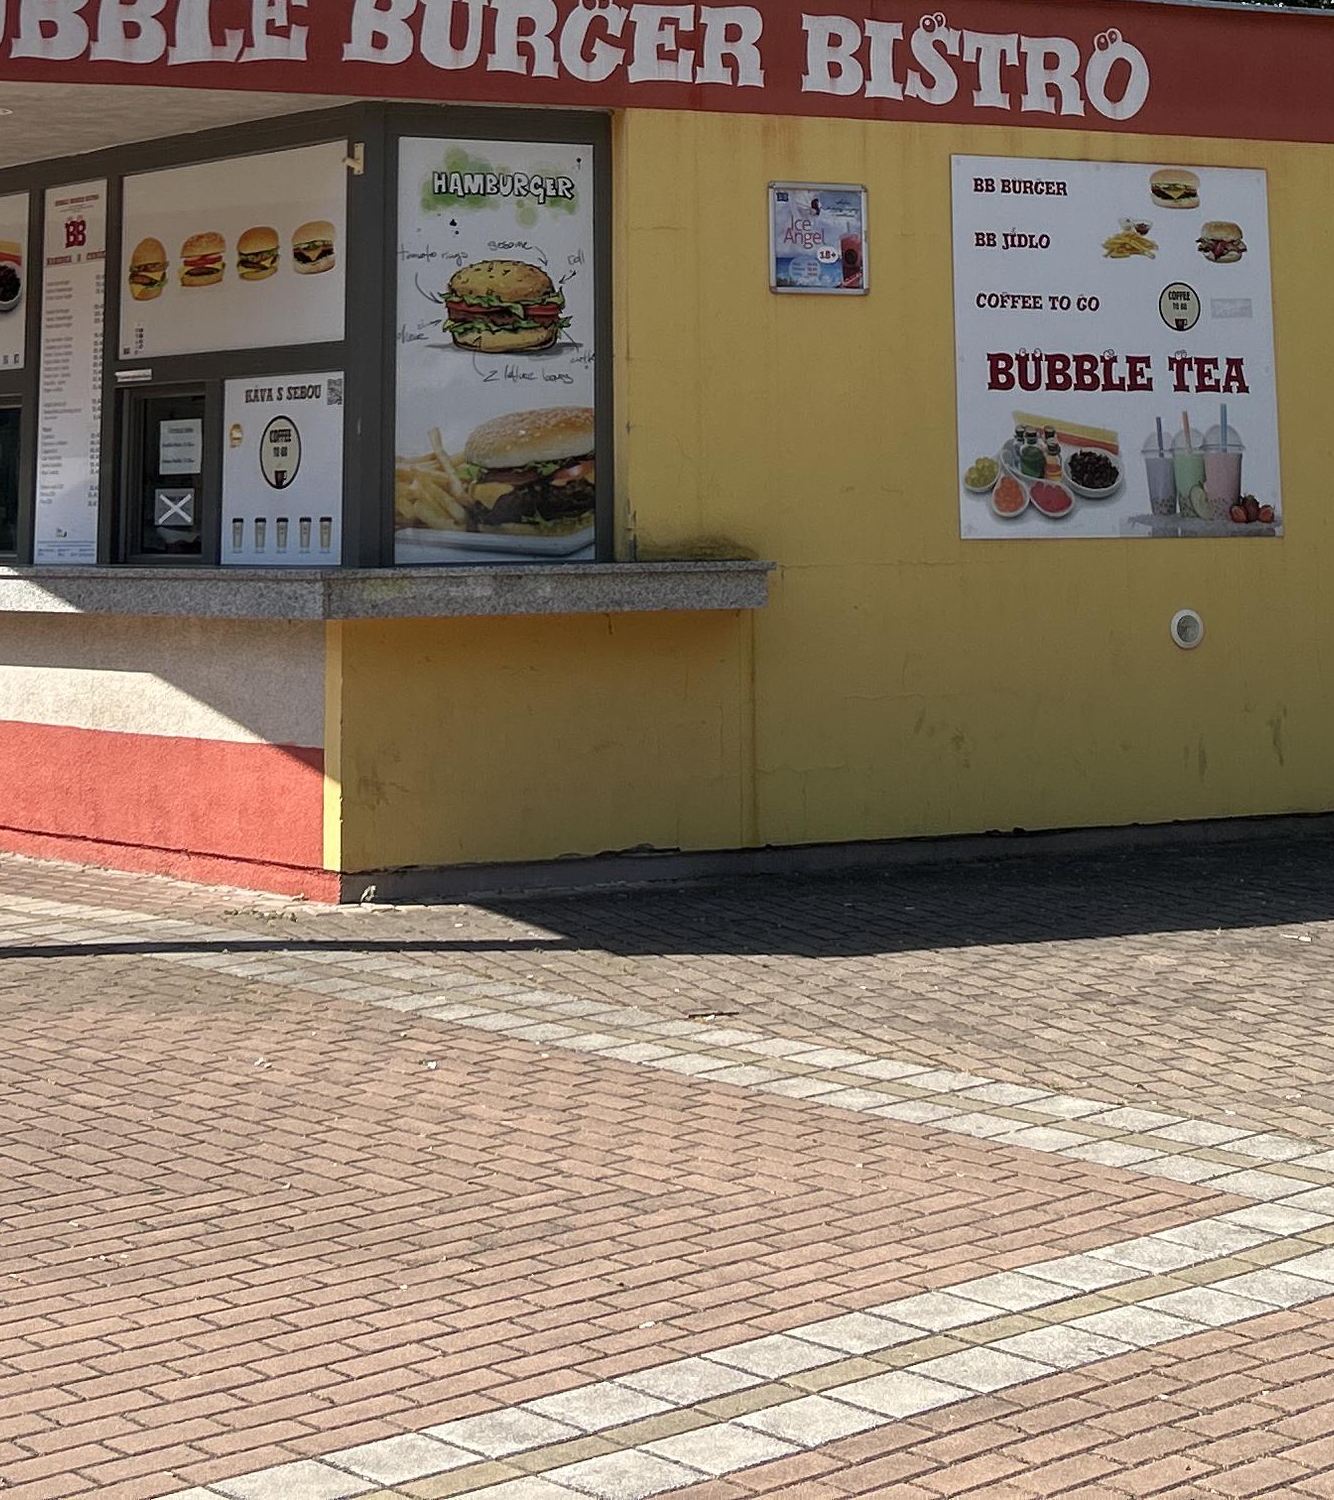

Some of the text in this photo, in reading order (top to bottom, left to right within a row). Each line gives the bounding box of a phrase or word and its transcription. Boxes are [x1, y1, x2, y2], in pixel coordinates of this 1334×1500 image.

[801, 12, 1150, 120] BISTRO
[433, 171, 575, 204] HAMBURGER
[973, 178, 1068, 196] BB BURGER
[65, 219, 86, 248] BB
[790, 215, 812, 231] Ice
[783, 227, 827, 249] Angel
[975, 232, 997, 247] BB
[976, 292, 1100, 312] COFFEE TO GO
[987, 348, 1250, 394] BUBBLE TEA
[245, 384, 322, 404] KÁVA S SEBOU
